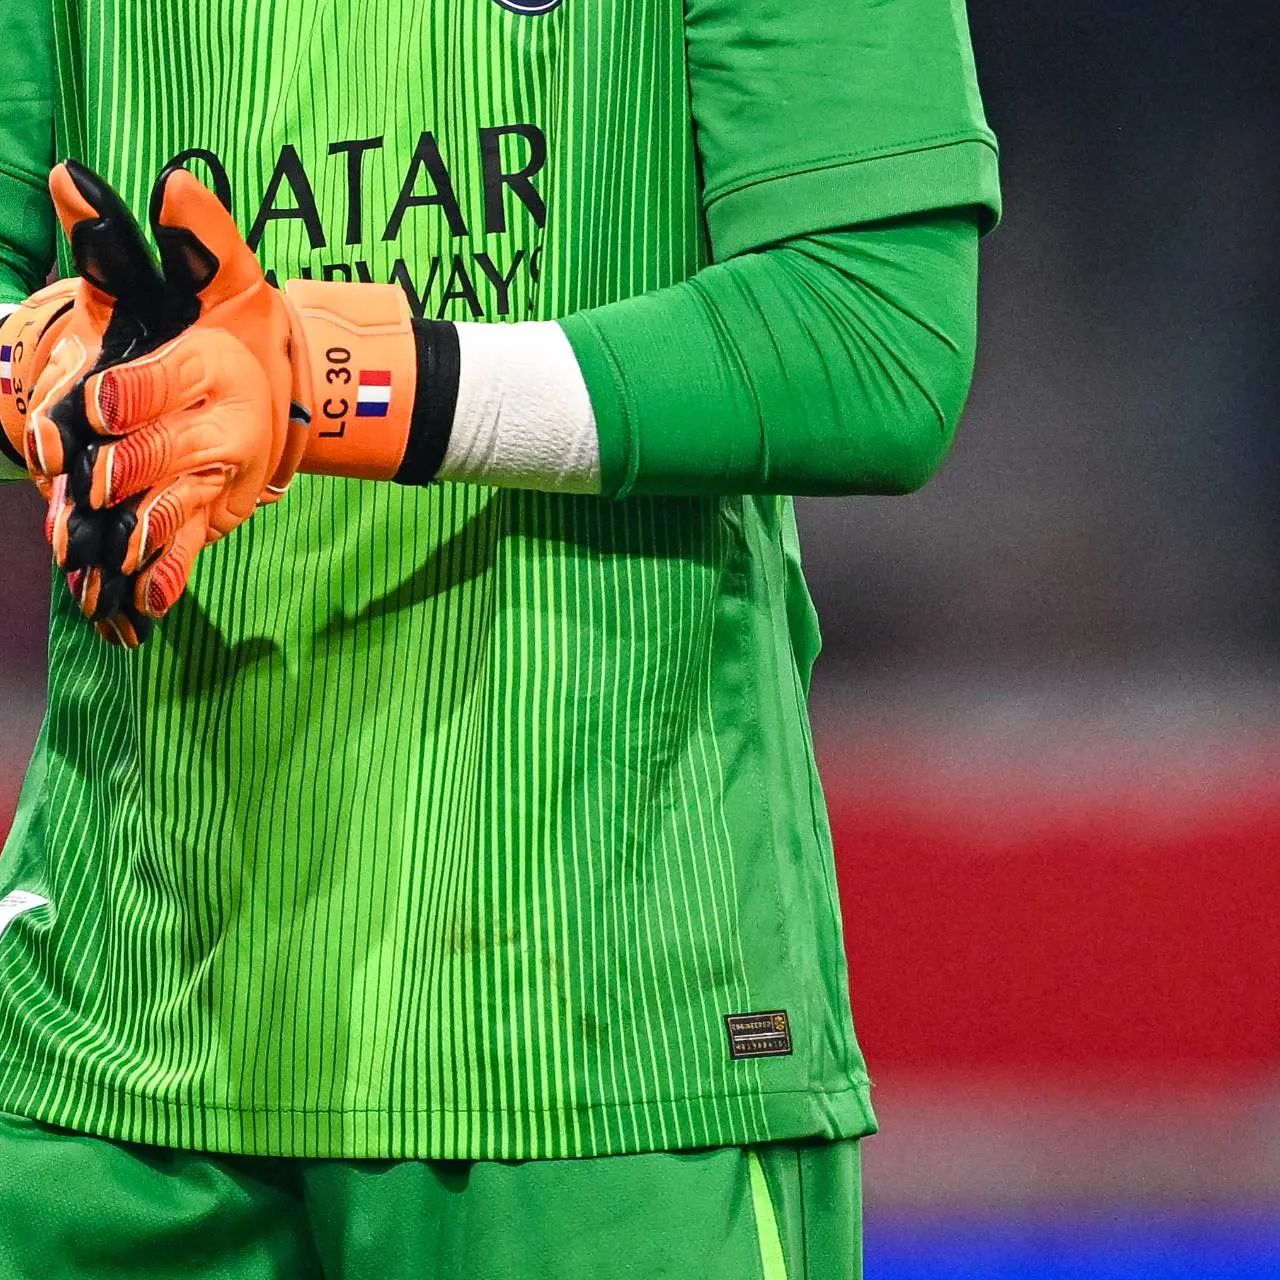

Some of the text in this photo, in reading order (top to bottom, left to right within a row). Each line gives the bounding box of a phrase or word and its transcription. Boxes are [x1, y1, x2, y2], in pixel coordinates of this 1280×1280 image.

[12, 377, 27, 415] 30
[318, 347, 352, 438] LC 30
